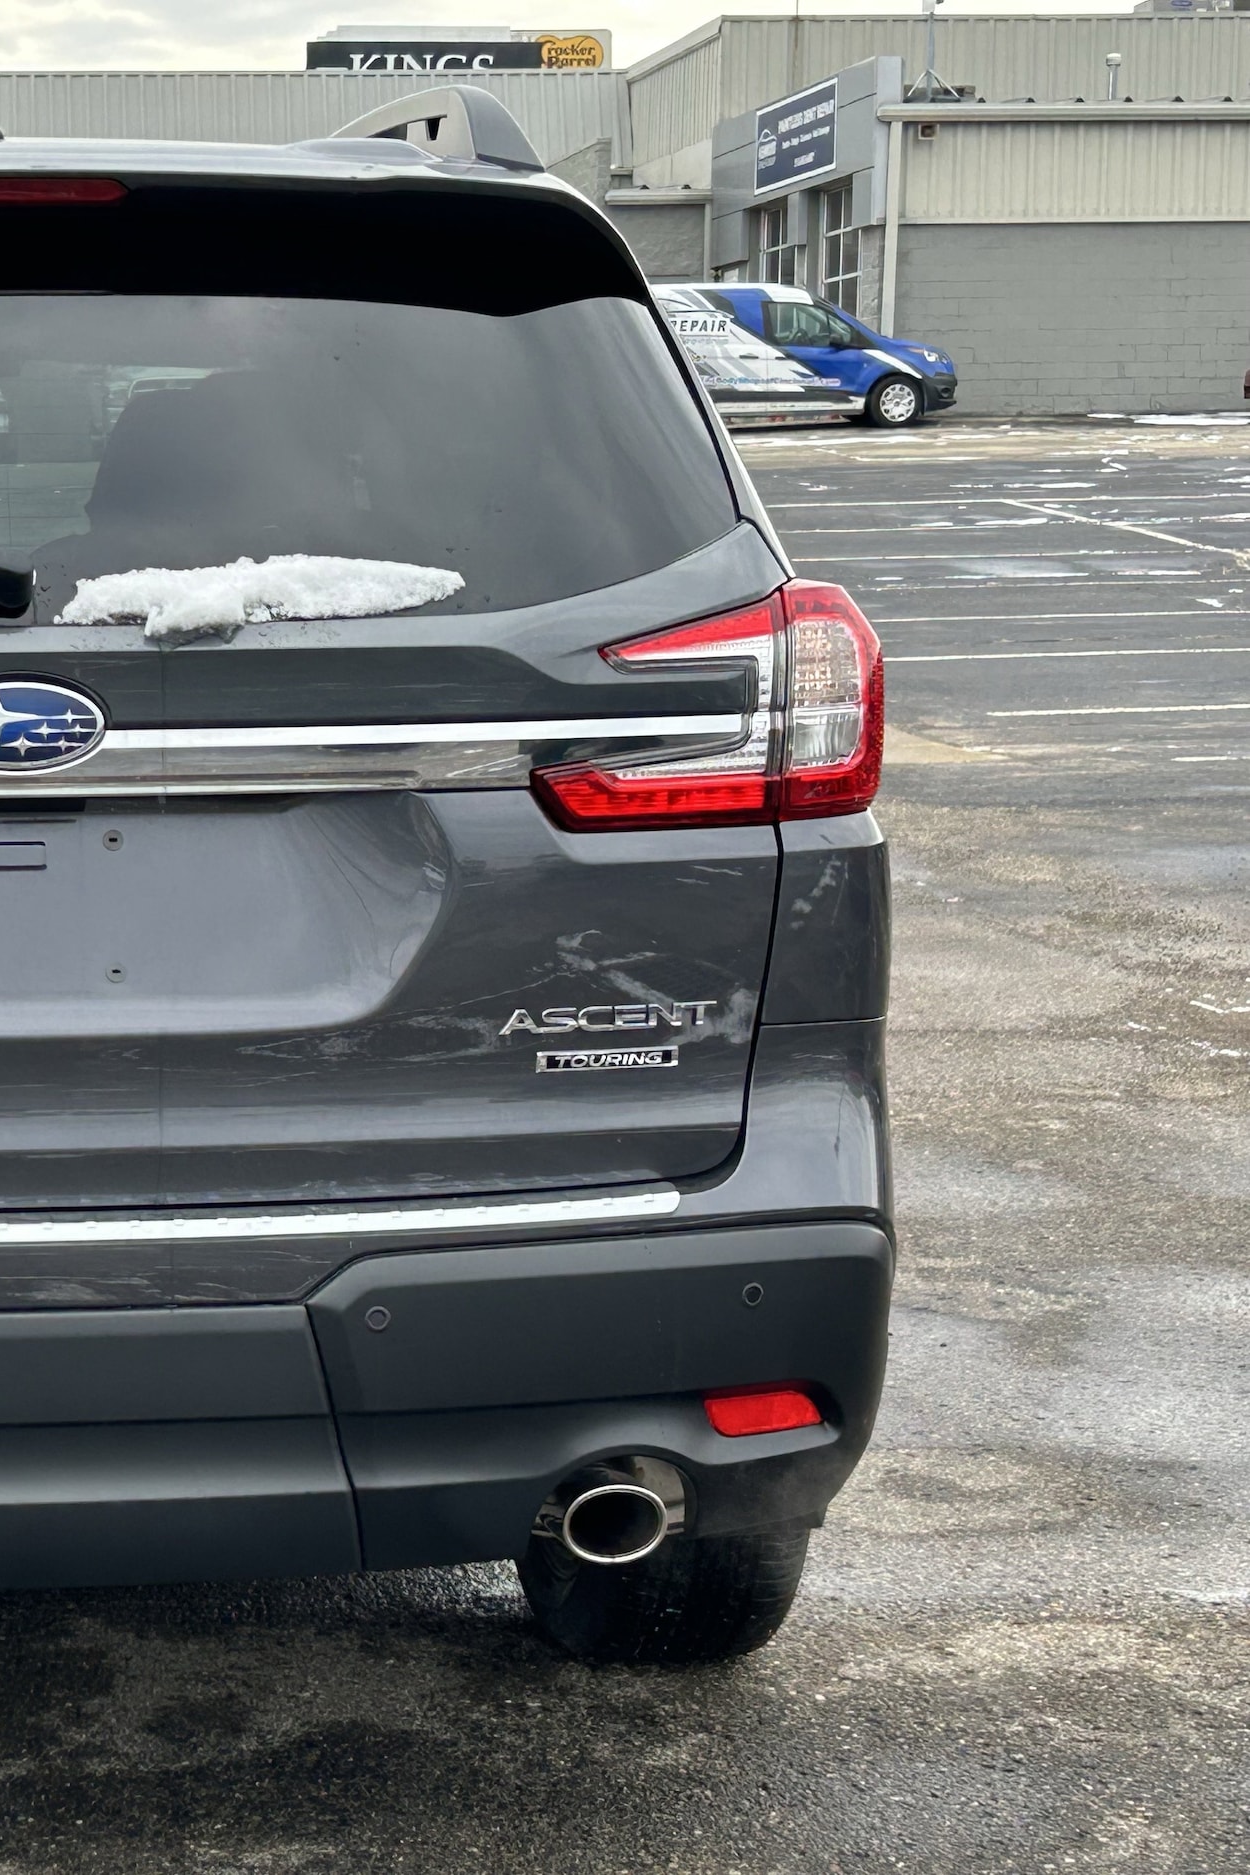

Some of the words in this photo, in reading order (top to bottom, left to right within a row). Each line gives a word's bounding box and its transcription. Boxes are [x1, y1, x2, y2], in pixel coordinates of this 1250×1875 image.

[542, 41, 595, 56] Cracker
[547, 55, 596, 68] Barrel
[498, 1000, 717, 1036] ASCENT
[554, 1051, 663, 1069] TOURING
